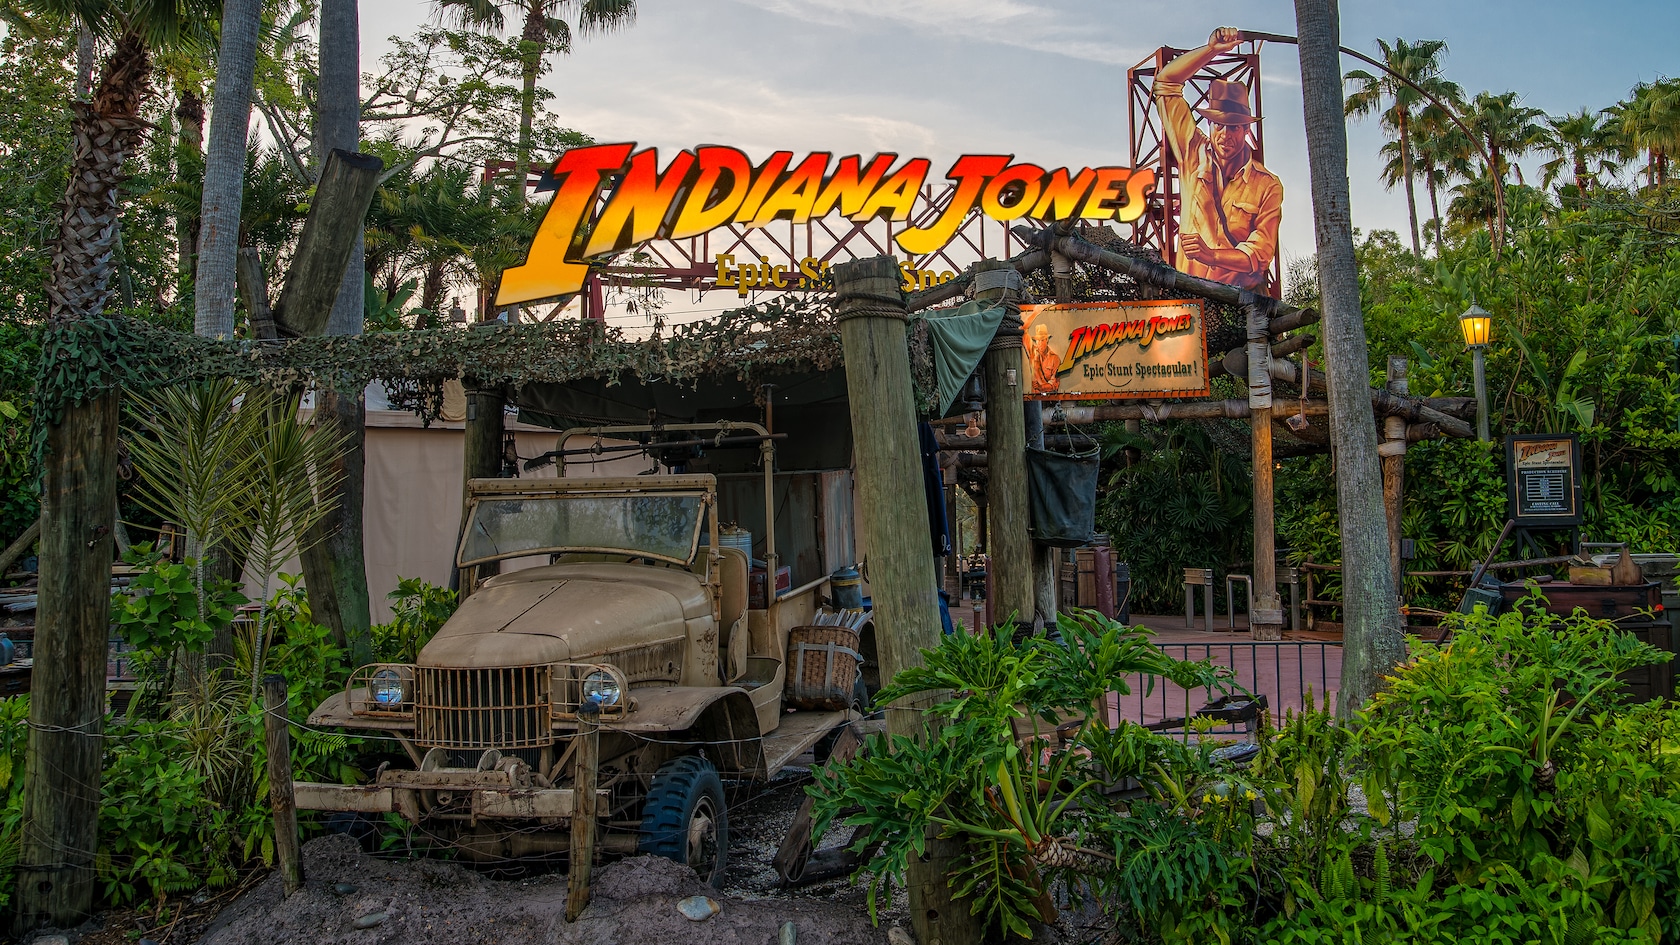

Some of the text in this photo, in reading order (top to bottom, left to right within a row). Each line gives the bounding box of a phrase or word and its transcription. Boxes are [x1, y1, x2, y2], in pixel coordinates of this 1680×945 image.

[495, 142, 1155, 306] INDIANA JONES
[715, 253, 788, 294] Epic
[1057, 313, 1192, 373] INDIANA JONES
[1083, 363, 1104, 380] Epic
[1107, 362, 1133, 376] Stunt
[1135, 360, 1192, 378] Spectacular
